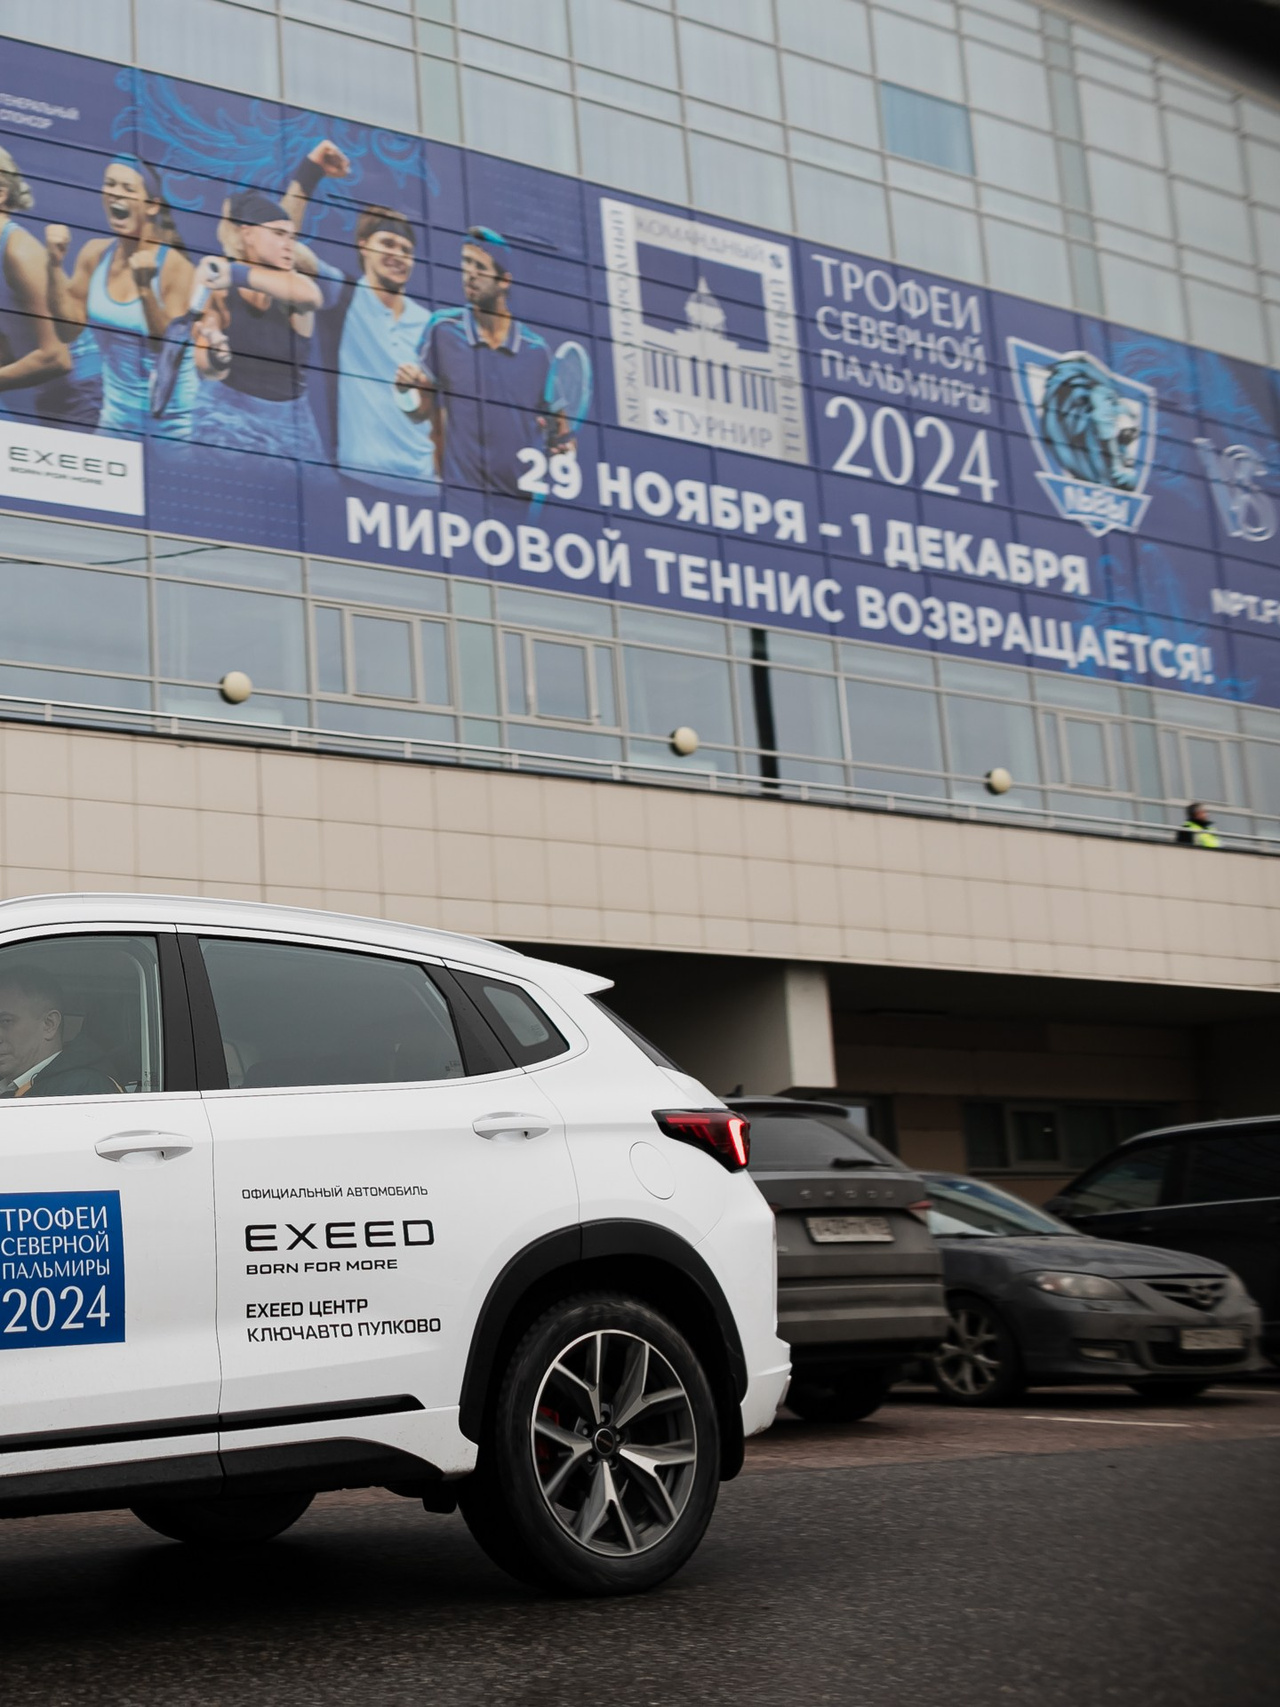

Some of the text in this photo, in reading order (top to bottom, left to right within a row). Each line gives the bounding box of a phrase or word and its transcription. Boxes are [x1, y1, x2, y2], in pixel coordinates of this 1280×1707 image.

[811, 253, 982, 334] ТРОФЕИ
[815, 306, 987, 375] СЕВЕРНОЙ
[820, 348, 991, 415] ПАЛЬМИРЫ
[673, 408, 773, 450] ТУРНИР
[9, 446, 128, 478] EXEED
[824, 396, 999, 503] 2024
[516, 447, 583, 500] 29
[597, 461, 808, 544] НОЯБРЯ
[850, 512, 873, 556] 1
[884, 519, 1091, 597] ДЕКАБРЯ
[345, 496, 1216, 685] МИРОВОЙ ТЕННИС ВОЗВРАЩАЕТСЯ!
[241, 1185, 429, 1200] ОФИЦИАЛЬНЫЙ АВТОМОБИЛЬ
[0, 1206, 108, 1232] ТРОФЕИ
[245, 1219, 435, 1252] EXEED
[0, 1230, 109, 1256] СЕВЕРНОЙ
[2, 1258, 110, 1280] ПАЛЬМИРЫ
[246, 1259, 398, 1275] BORN FOR MORE
[2, 1284, 111, 1333] 2024
[246, 1299, 369, 1318] EXEED ЦЕНТР
[247, 1318, 441, 1342] КЛЮЧАВТО ПУЛКОВО
